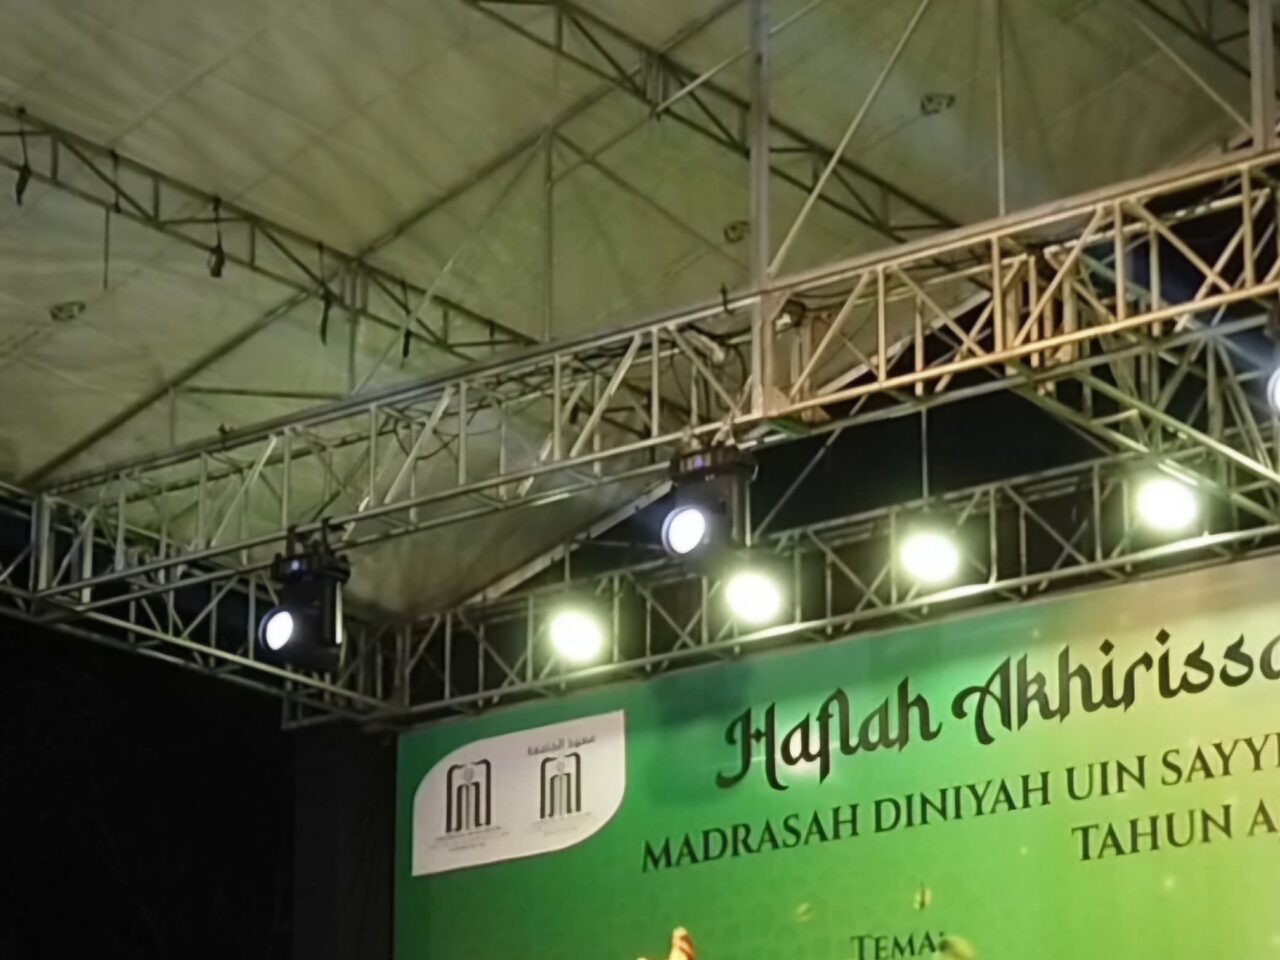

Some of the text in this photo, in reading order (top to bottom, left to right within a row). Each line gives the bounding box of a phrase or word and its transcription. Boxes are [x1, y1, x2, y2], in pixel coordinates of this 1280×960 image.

[715, 676, 942, 790] Haflah
[642, 804, 859, 872] MADRASAH
[874, 771, 1051, 832] DINIYAH
[1065, 755, 1147, 801] UIN
[1071, 805, 1232, 861] TAHUN
